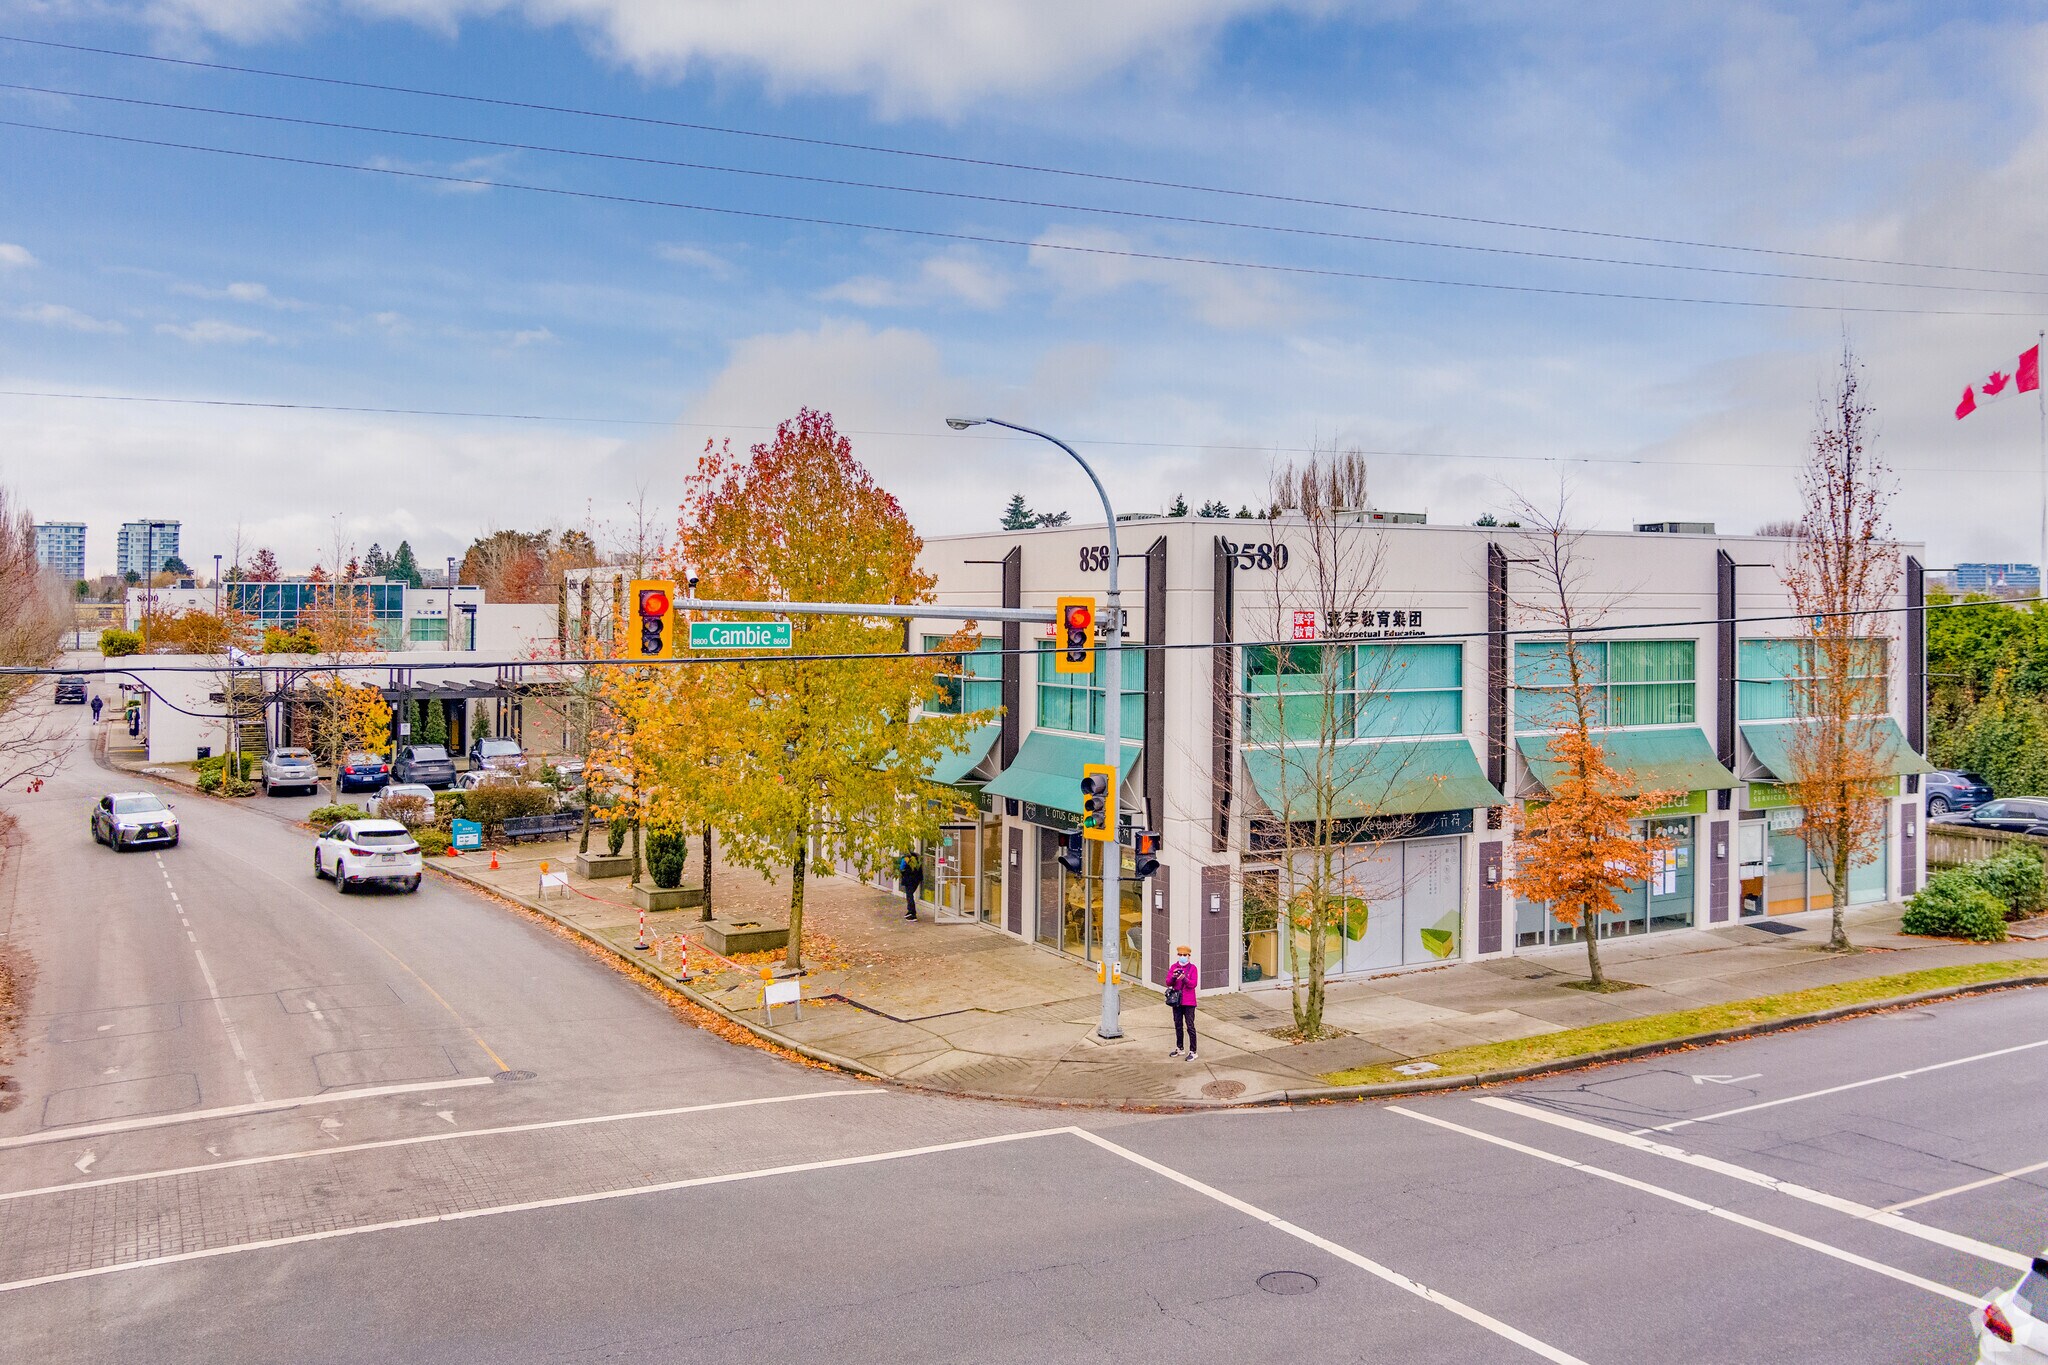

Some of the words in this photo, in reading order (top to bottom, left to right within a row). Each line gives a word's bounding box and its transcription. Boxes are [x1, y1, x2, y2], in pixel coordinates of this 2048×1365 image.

[1080, 545, 1119, 571] 858
[709, 626, 771, 645] Cambie
[1384, 629, 1425, 637] Education
[1753, 794, 1786, 803] SERVICES
